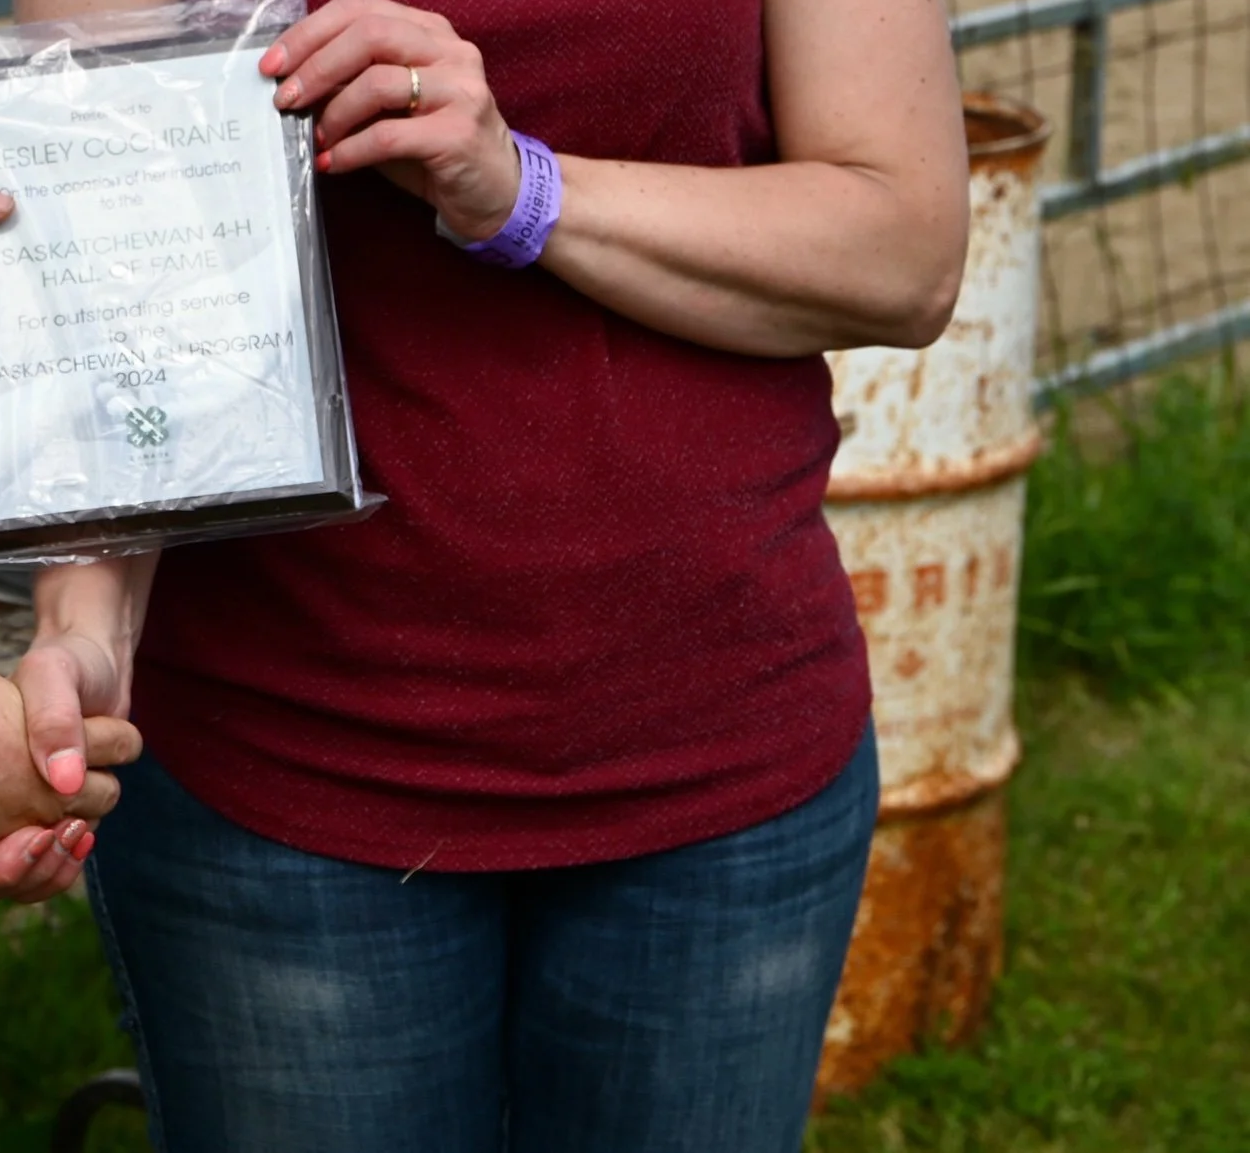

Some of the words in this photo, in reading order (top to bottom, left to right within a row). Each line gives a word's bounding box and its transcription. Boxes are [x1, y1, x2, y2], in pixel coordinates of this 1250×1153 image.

[138, 103, 153, 115] to
[24, 184, 49, 199] the
[124, 169, 139, 187] of
[142, 168, 167, 183] her
[170, 159, 242, 180] induction
[99, 196, 116, 210] to
[513, 147, 553, 250] EXHIBITION
[1, 224, 204, 267] SASKATCHEWAN
[212, 218, 252, 239] 4-H
[41, 264, 102, 289] HALL
[109, 258, 144, 280] OF
[150, 249, 219, 277] FAME
[17, 313, 48, 331] For
[53, 298, 174, 328] outstanding
[180, 291, 250, 312] service
[108, 328, 128, 345] to
[188, 329, 294, 356] PROGRAM
[114, 367, 166, 390] 2024
